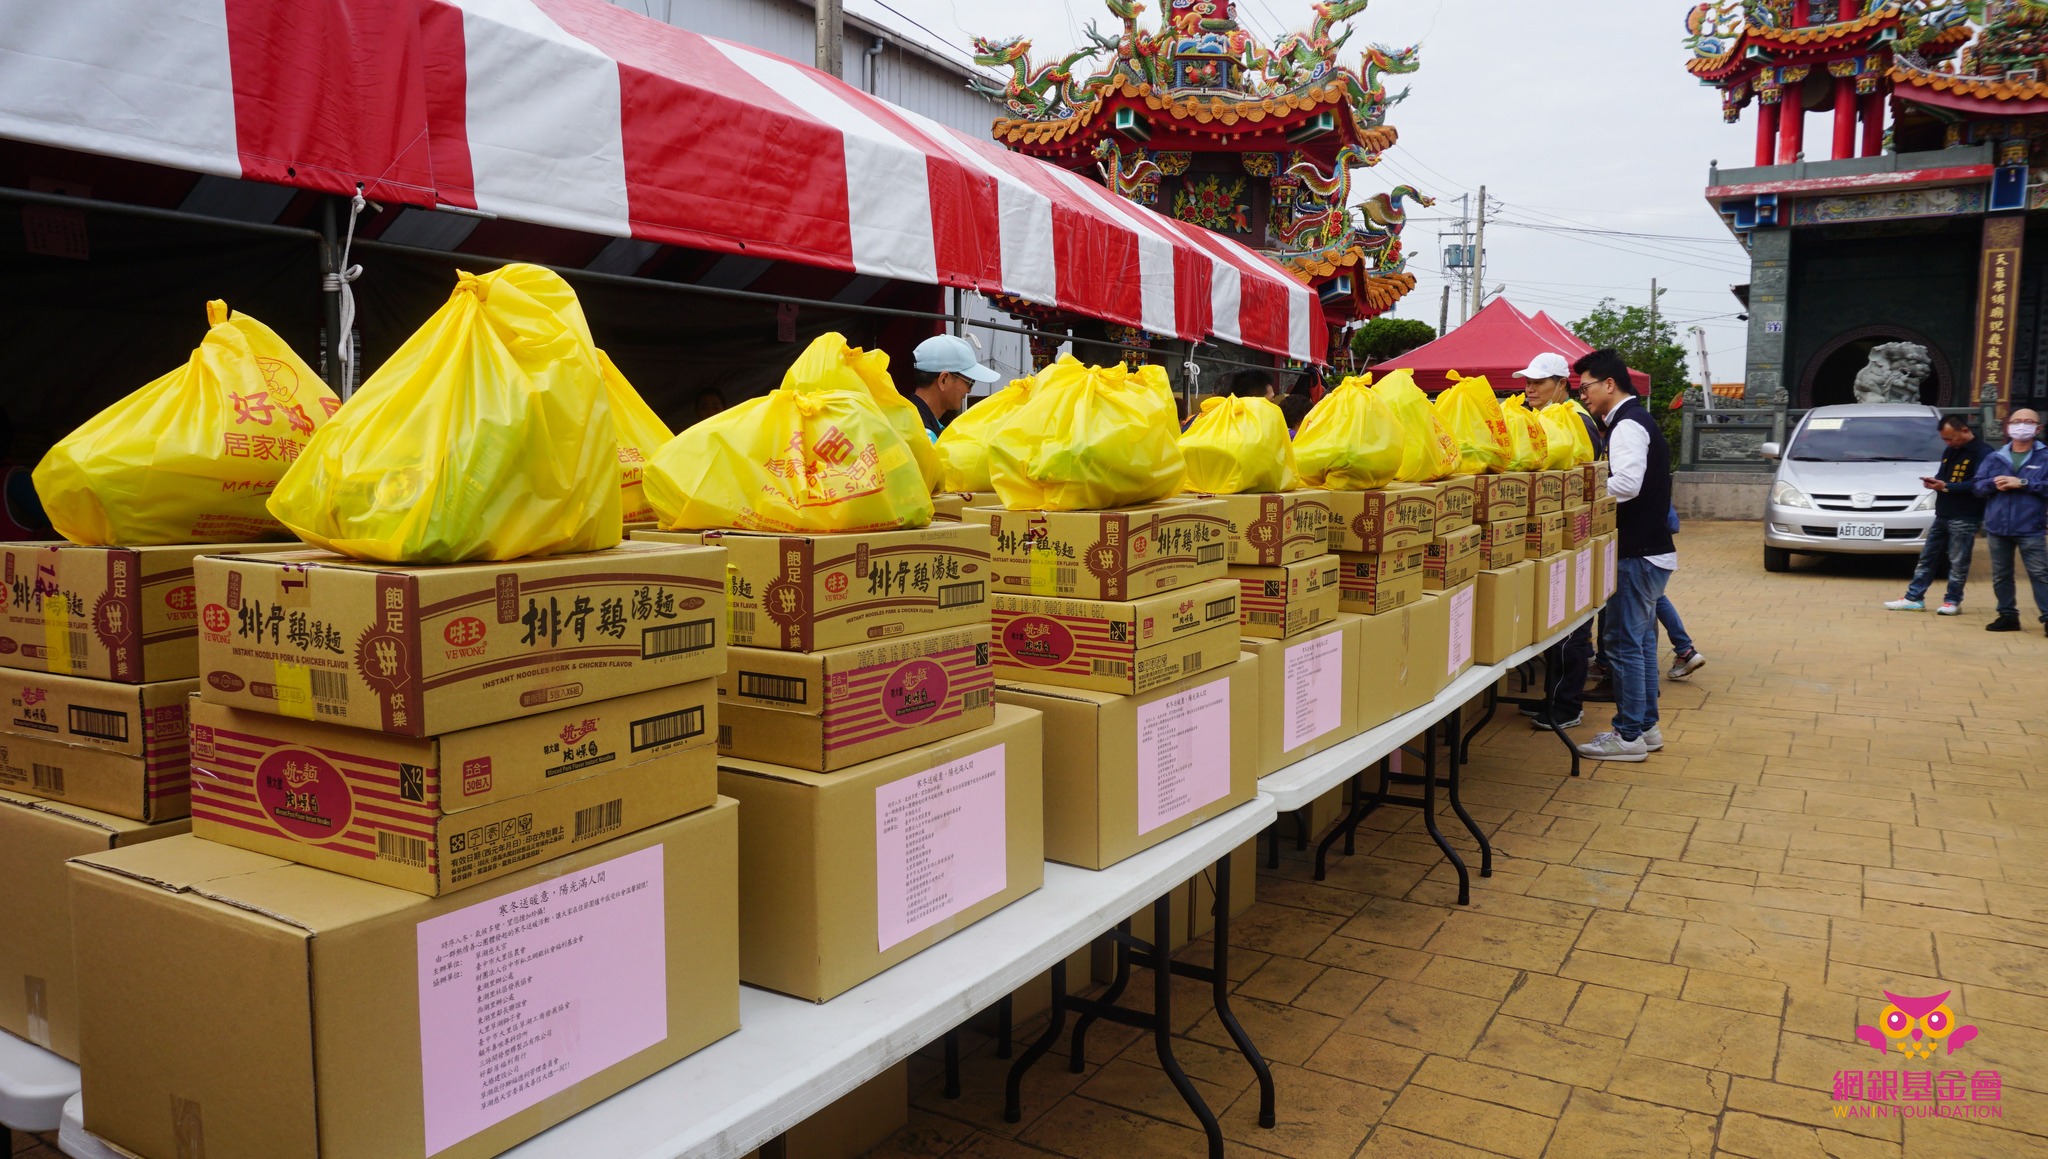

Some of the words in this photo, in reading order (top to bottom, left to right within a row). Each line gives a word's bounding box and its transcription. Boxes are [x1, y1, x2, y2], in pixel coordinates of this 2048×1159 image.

[224, 431, 308, 463] 居家精
[1106, 520, 1119, 546] 飽足
[786, 551, 801, 583] 飽足
[1098, 550, 1115, 570] 拼
[113, 560, 127, 598] 飽足
[385, 587, 404, 634] 飽足
[778, 589, 796, 613] 拼
[105, 604, 122, 634] 拼
[205, 606, 227, 630] 味王
[449, 621, 481, 645] 味王
[789, 624, 802, 649] 快樂
[232, 647, 254, 657] INSTANT
[255, 650, 280, 660] NOODLES
[280, 653, 295, 663] PORK
[301, 656, 326, 666] CHICKEN
[327, 659, 349, 669] FLAVOR
[374, 640, 398, 676] 拼
[482, 674, 515, 690] INSTANT
[516, 667, 550, 680] NOODLES
[551, 663, 570, 673] PORK
[578, 660, 608, 670] CHICKEN
[609, 660, 633, 669] FLAVOR
[317, 702, 347, 718] 販售專用
[390, 693, 408, 728] 快樂
[196, 728, 212, 740] 五合一
[560, 718, 598, 744] 統一麵
[283, 760, 320, 788] 統一麵
[410, 768, 422, 784] 12
[465, 762, 490, 777] 五合一
[466, 777, 490, 792] 30包入
